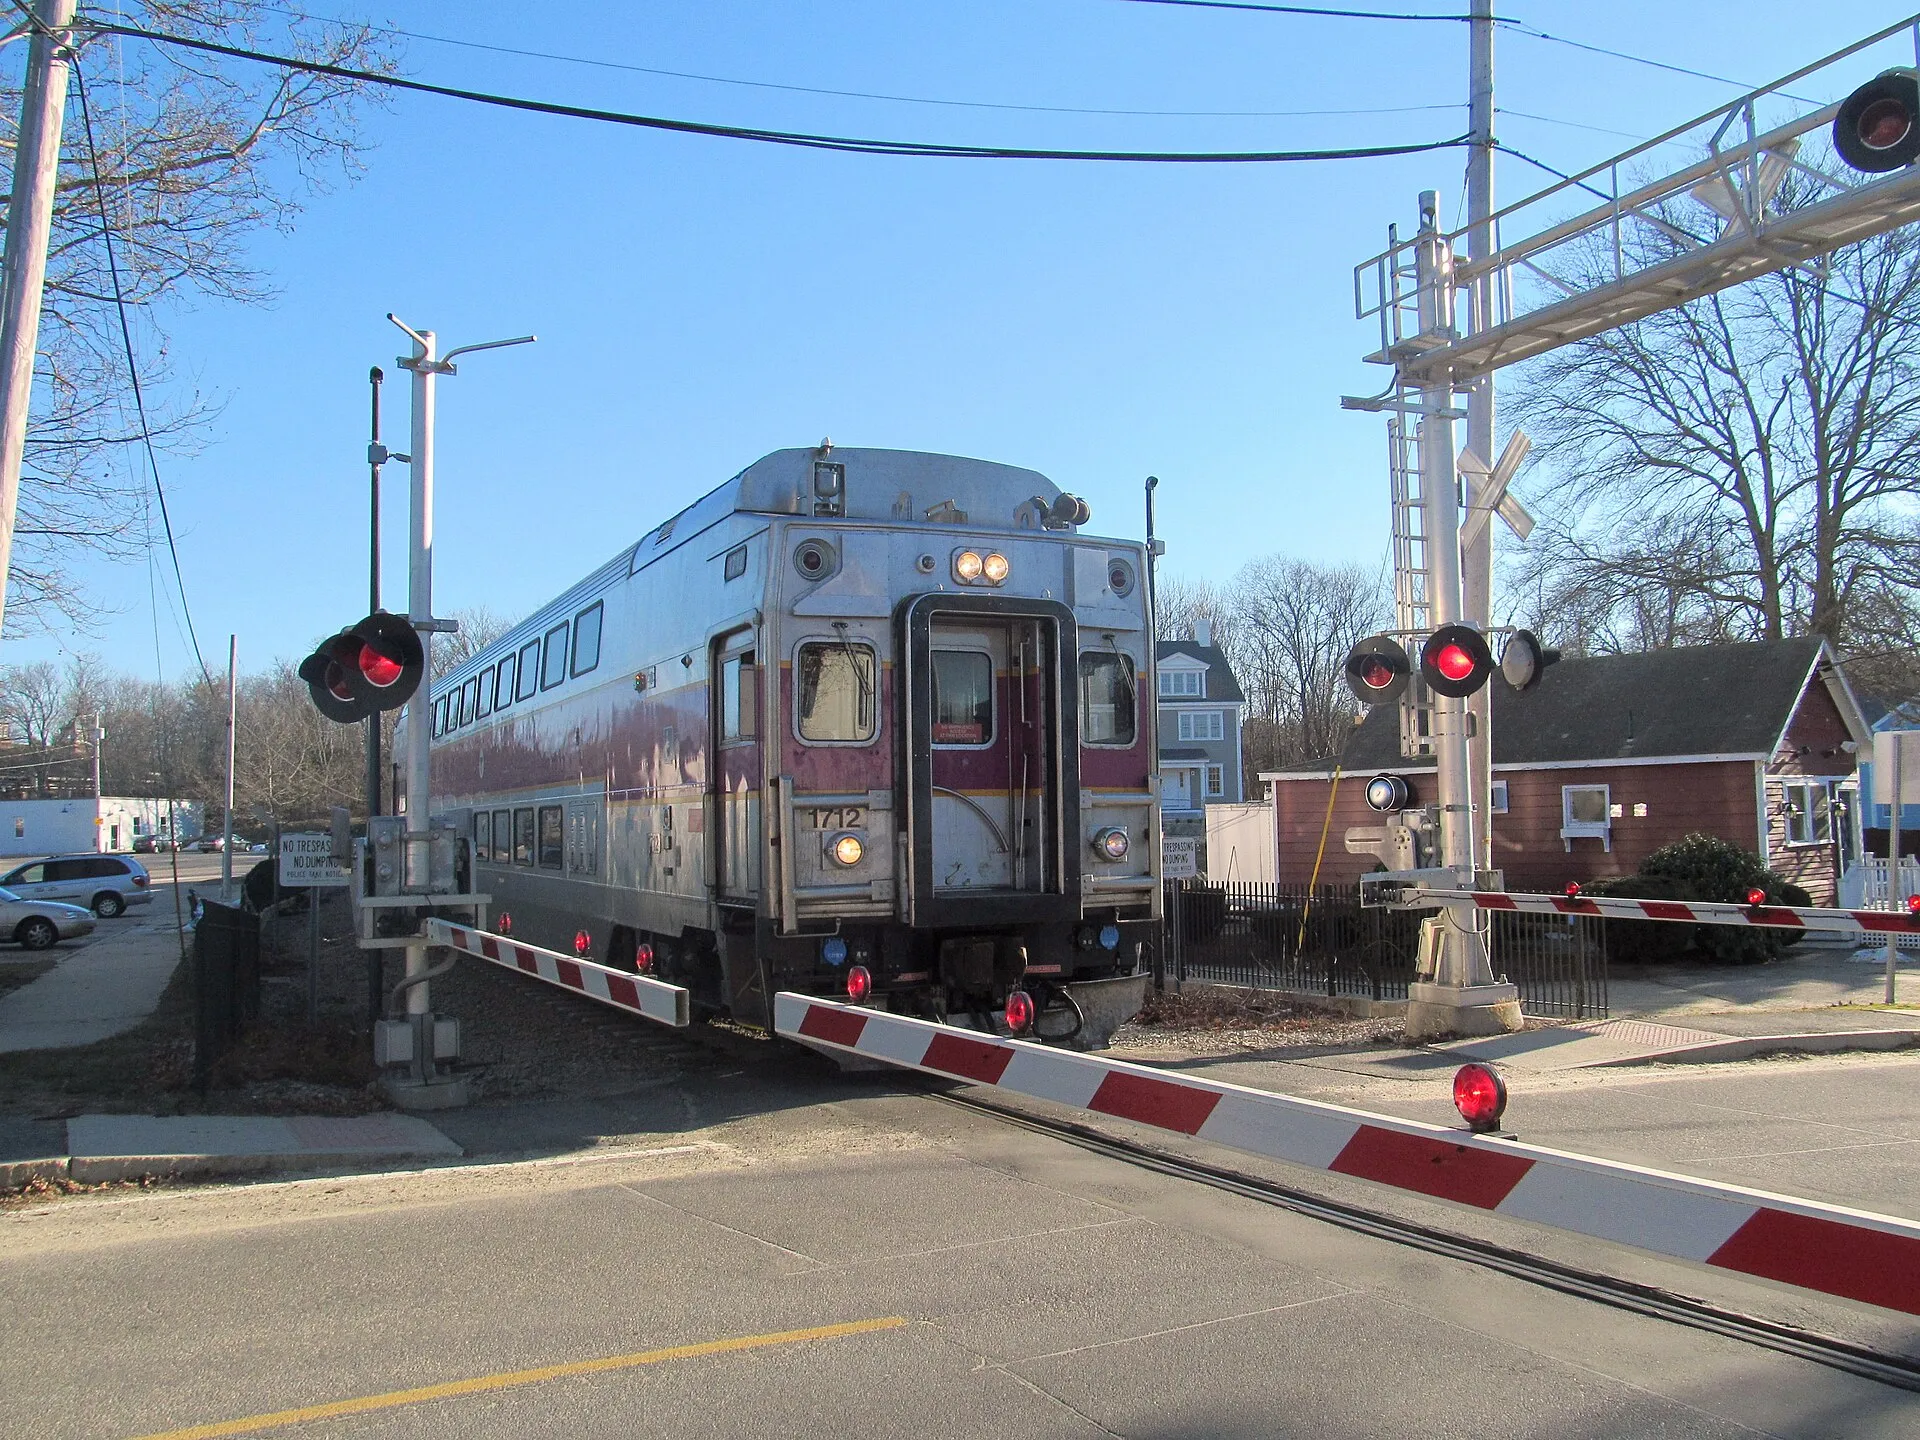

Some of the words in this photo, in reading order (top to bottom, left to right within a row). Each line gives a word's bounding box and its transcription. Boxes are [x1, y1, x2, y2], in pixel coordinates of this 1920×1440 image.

[808, 808, 860, 828] 1712
[283, 840, 294, 852] NO
[297, 840, 331, 852] TRESPAS
[294, 856, 304, 868] NO
